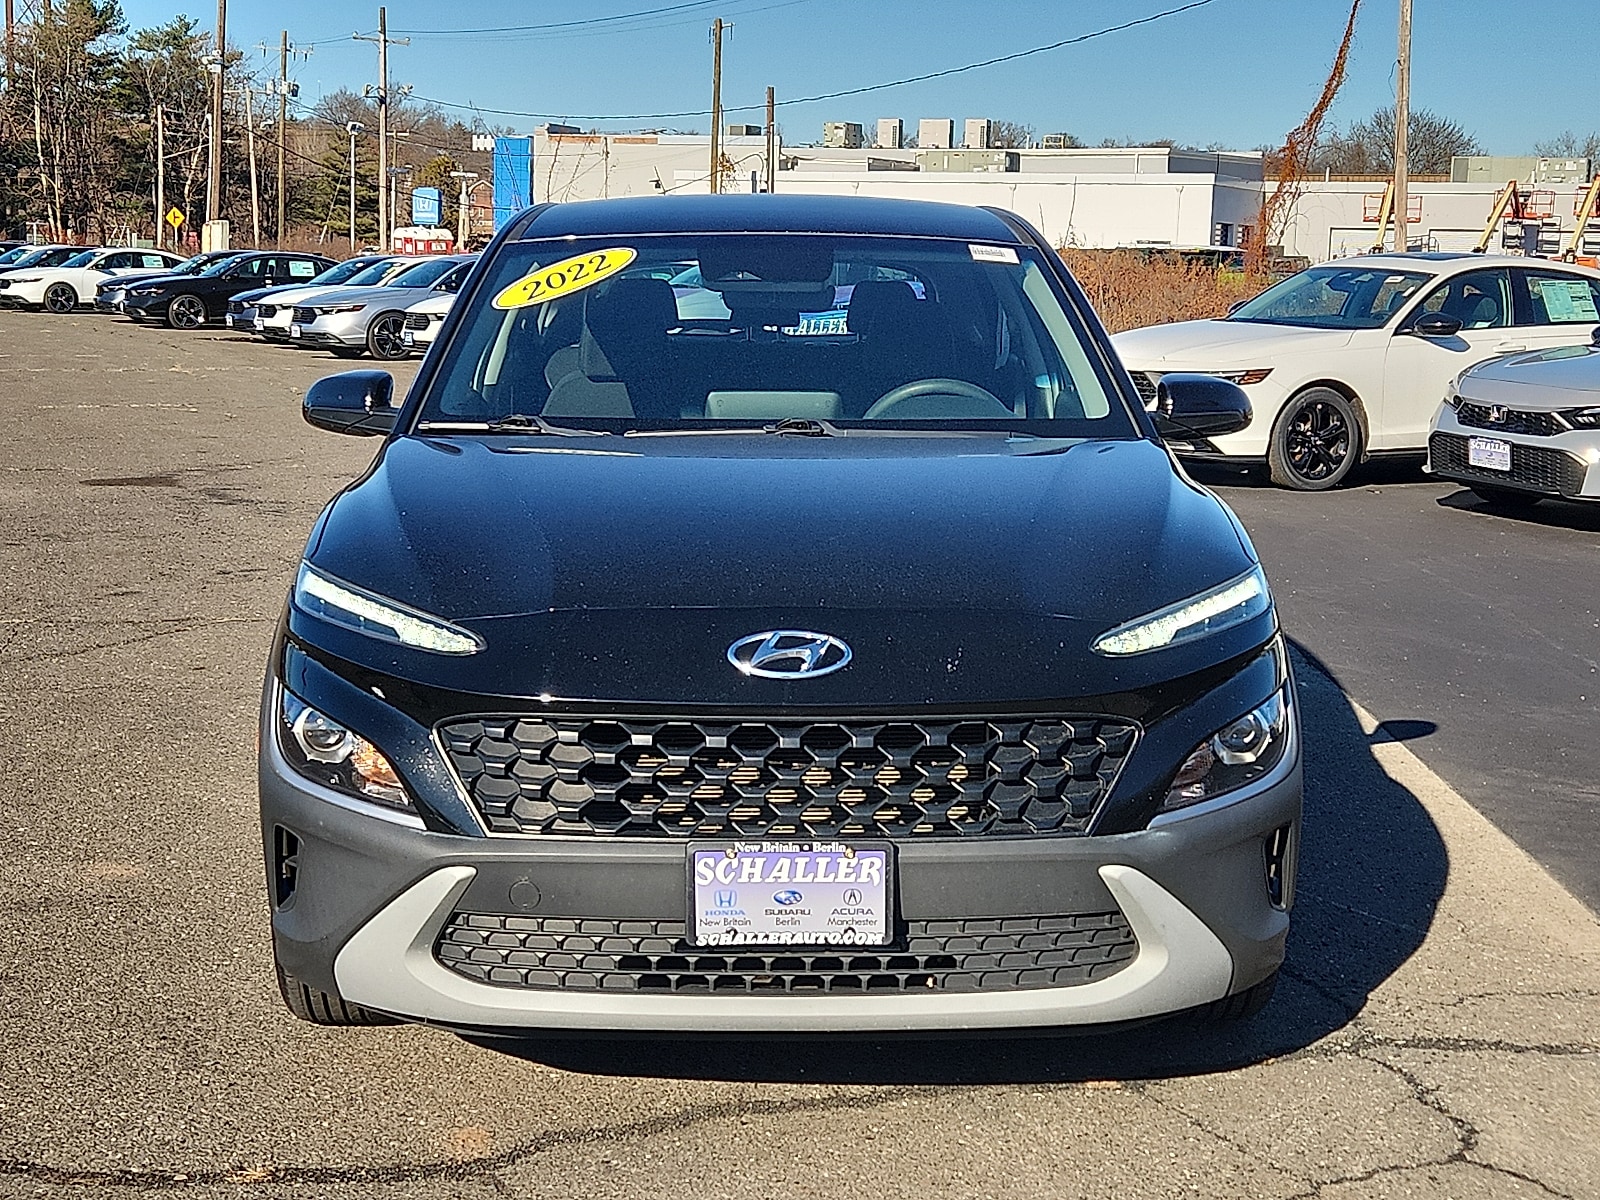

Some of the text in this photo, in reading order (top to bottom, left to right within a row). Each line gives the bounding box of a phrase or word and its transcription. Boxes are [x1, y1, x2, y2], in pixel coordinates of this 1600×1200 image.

[522, 254, 612, 300] 2022
[733, 841, 847, 853] New Britain Berlin
[695, 856, 883, 887] SCHALLER
[704, 909, 746, 917] HONDA
[764, 908, 811, 916] SUBARU
[831, 908, 874, 916] ACURA
[699, 917, 752, 927] New Britain
[775, 917, 801, 926] Berlin
[827, 917, 878, 926] Manchester
[696, 931, 884, 947] SCHALLERAUTO.COM
